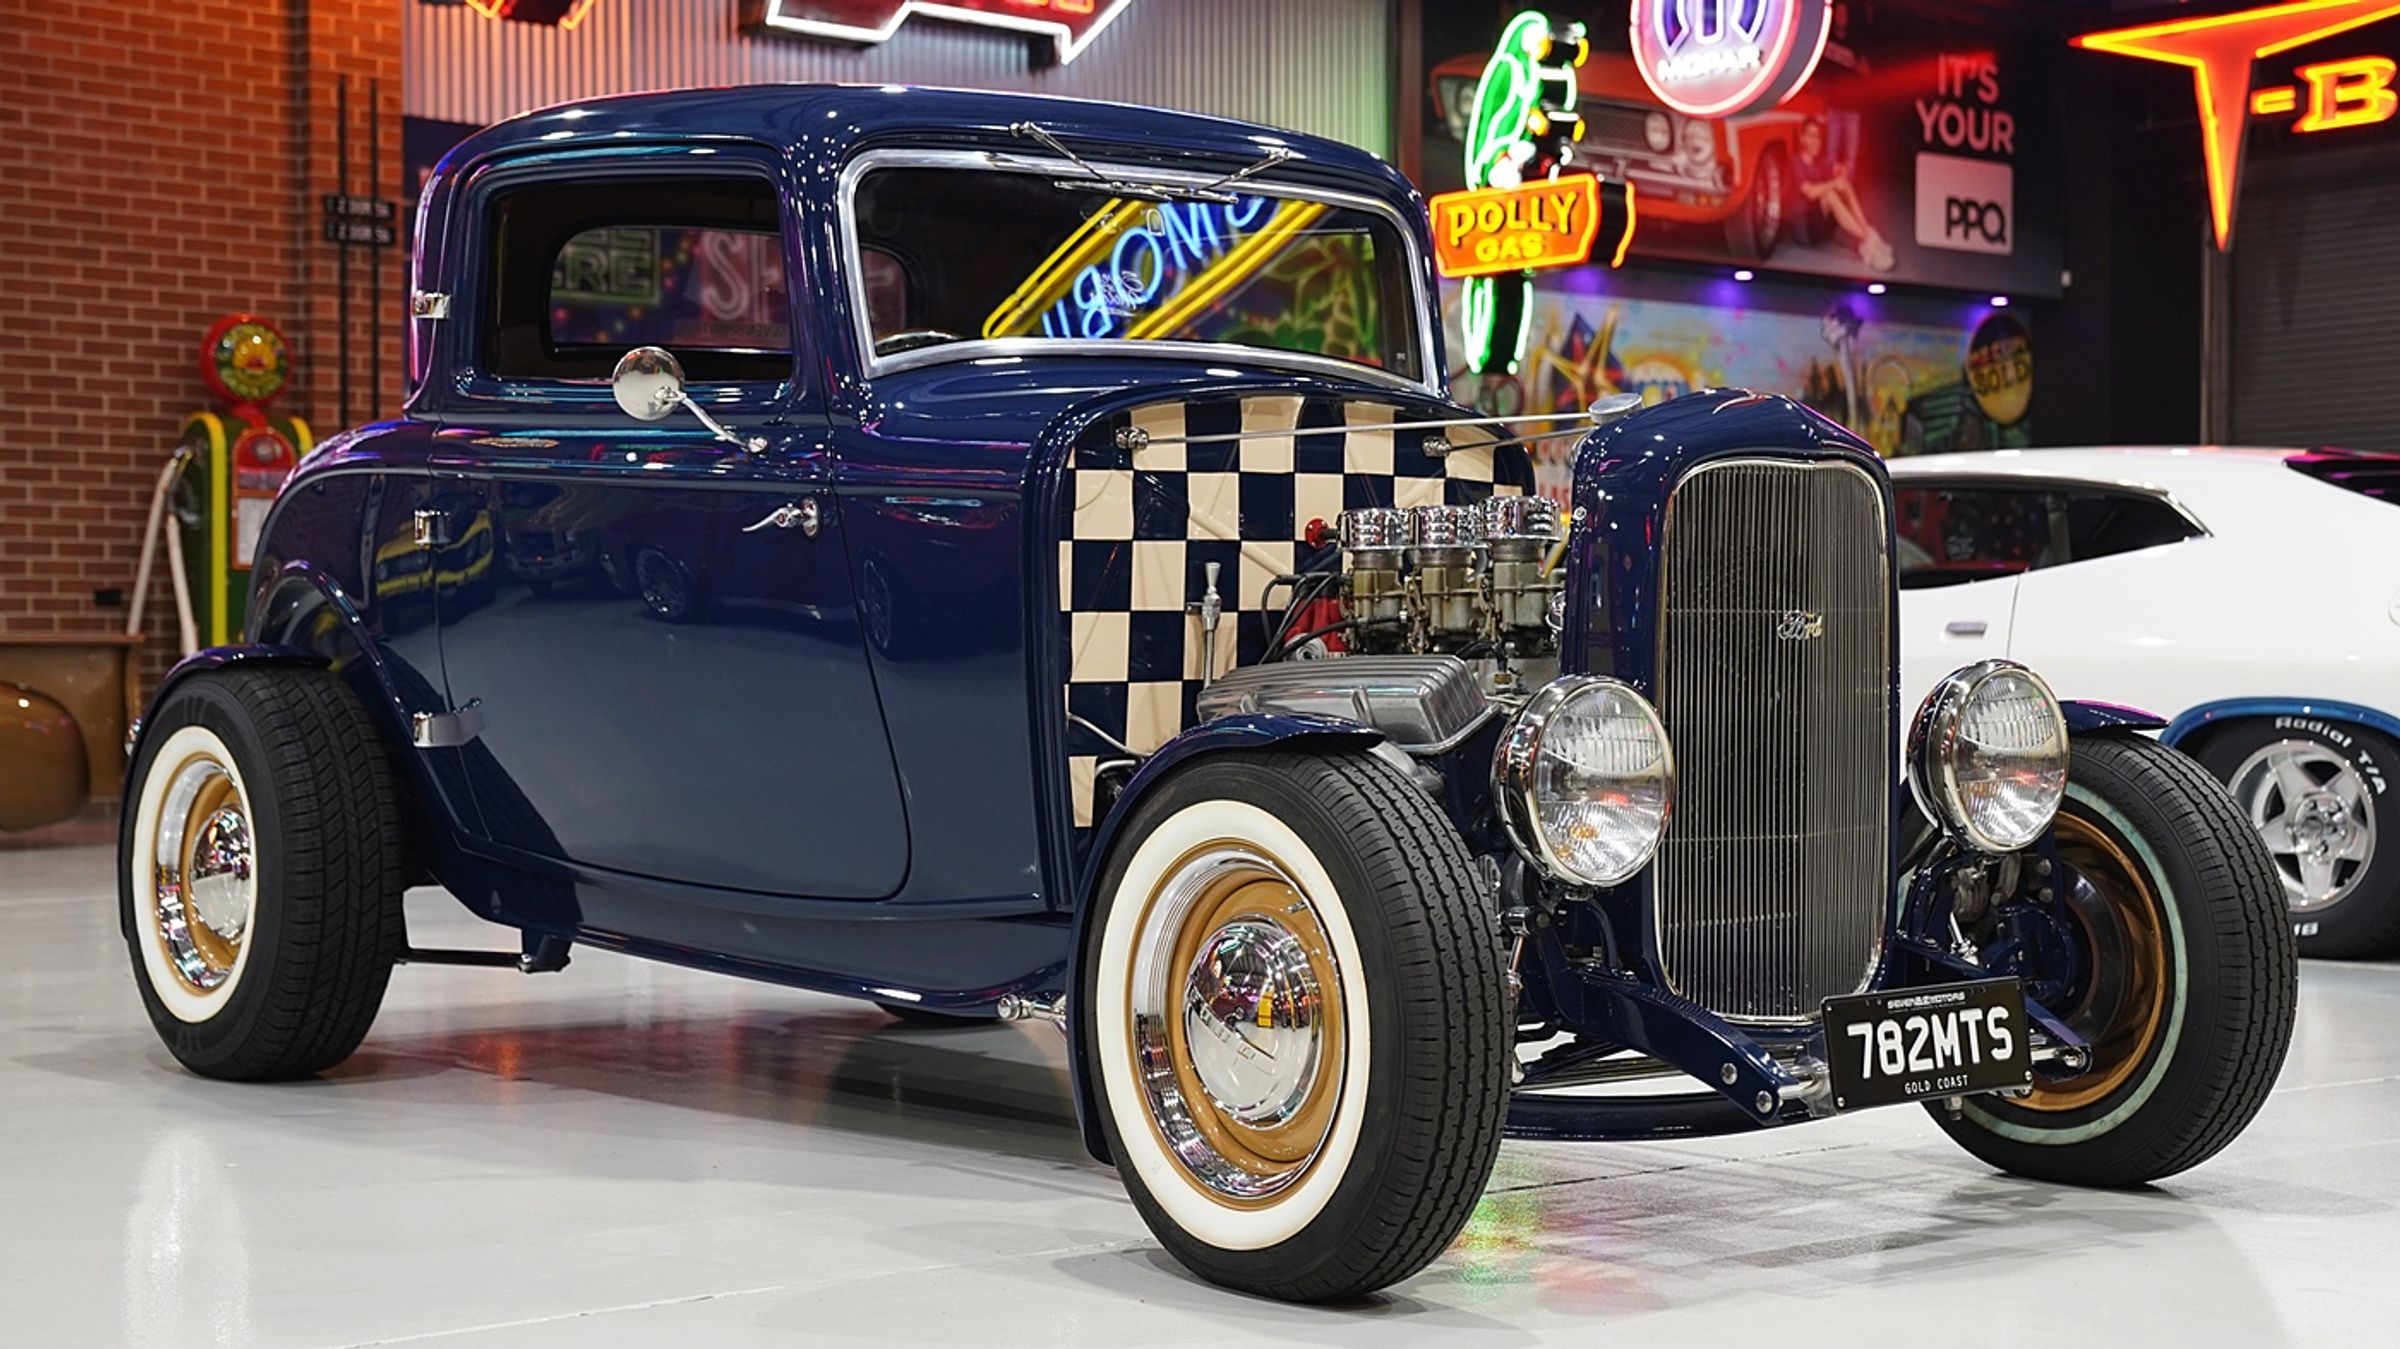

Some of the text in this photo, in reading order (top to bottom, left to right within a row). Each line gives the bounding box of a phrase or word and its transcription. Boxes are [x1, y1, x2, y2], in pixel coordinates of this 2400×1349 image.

[1656, 44, 1763, 83] MOPAR
[1937, 53, 1999, 104] IT'S
[1915, 98, 2015, 154] YOUR
[1446, 190, 1578, 247] POLLY
[1946, 196, 2007, 246] PPQ
[1474, 231, 1545, 263] GAS
[2275, 716, 2387, 795] Radial T/A
[1846, 1006, 2014, 1080] 782MTS
[1904, 1074, 1969, 1095] GOLD COAST
